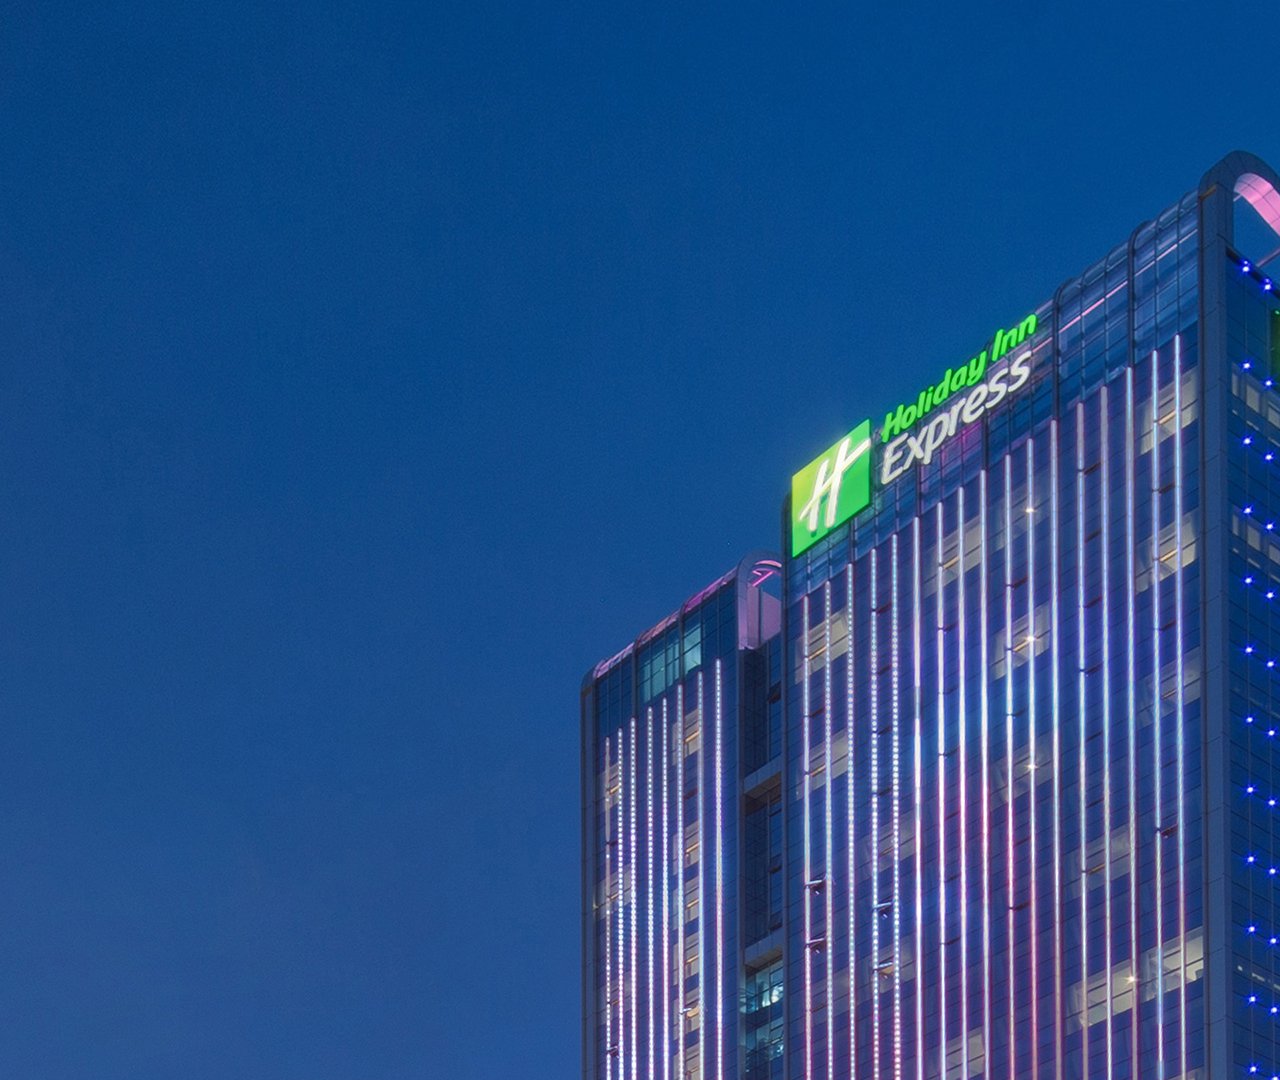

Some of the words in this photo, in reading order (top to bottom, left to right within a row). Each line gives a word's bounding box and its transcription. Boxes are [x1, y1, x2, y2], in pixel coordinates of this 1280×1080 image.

[880, 350, 1032, 485] Express
[881, 351, 987, 443] Holiday
[991, 313, 1038, 362] Inn
